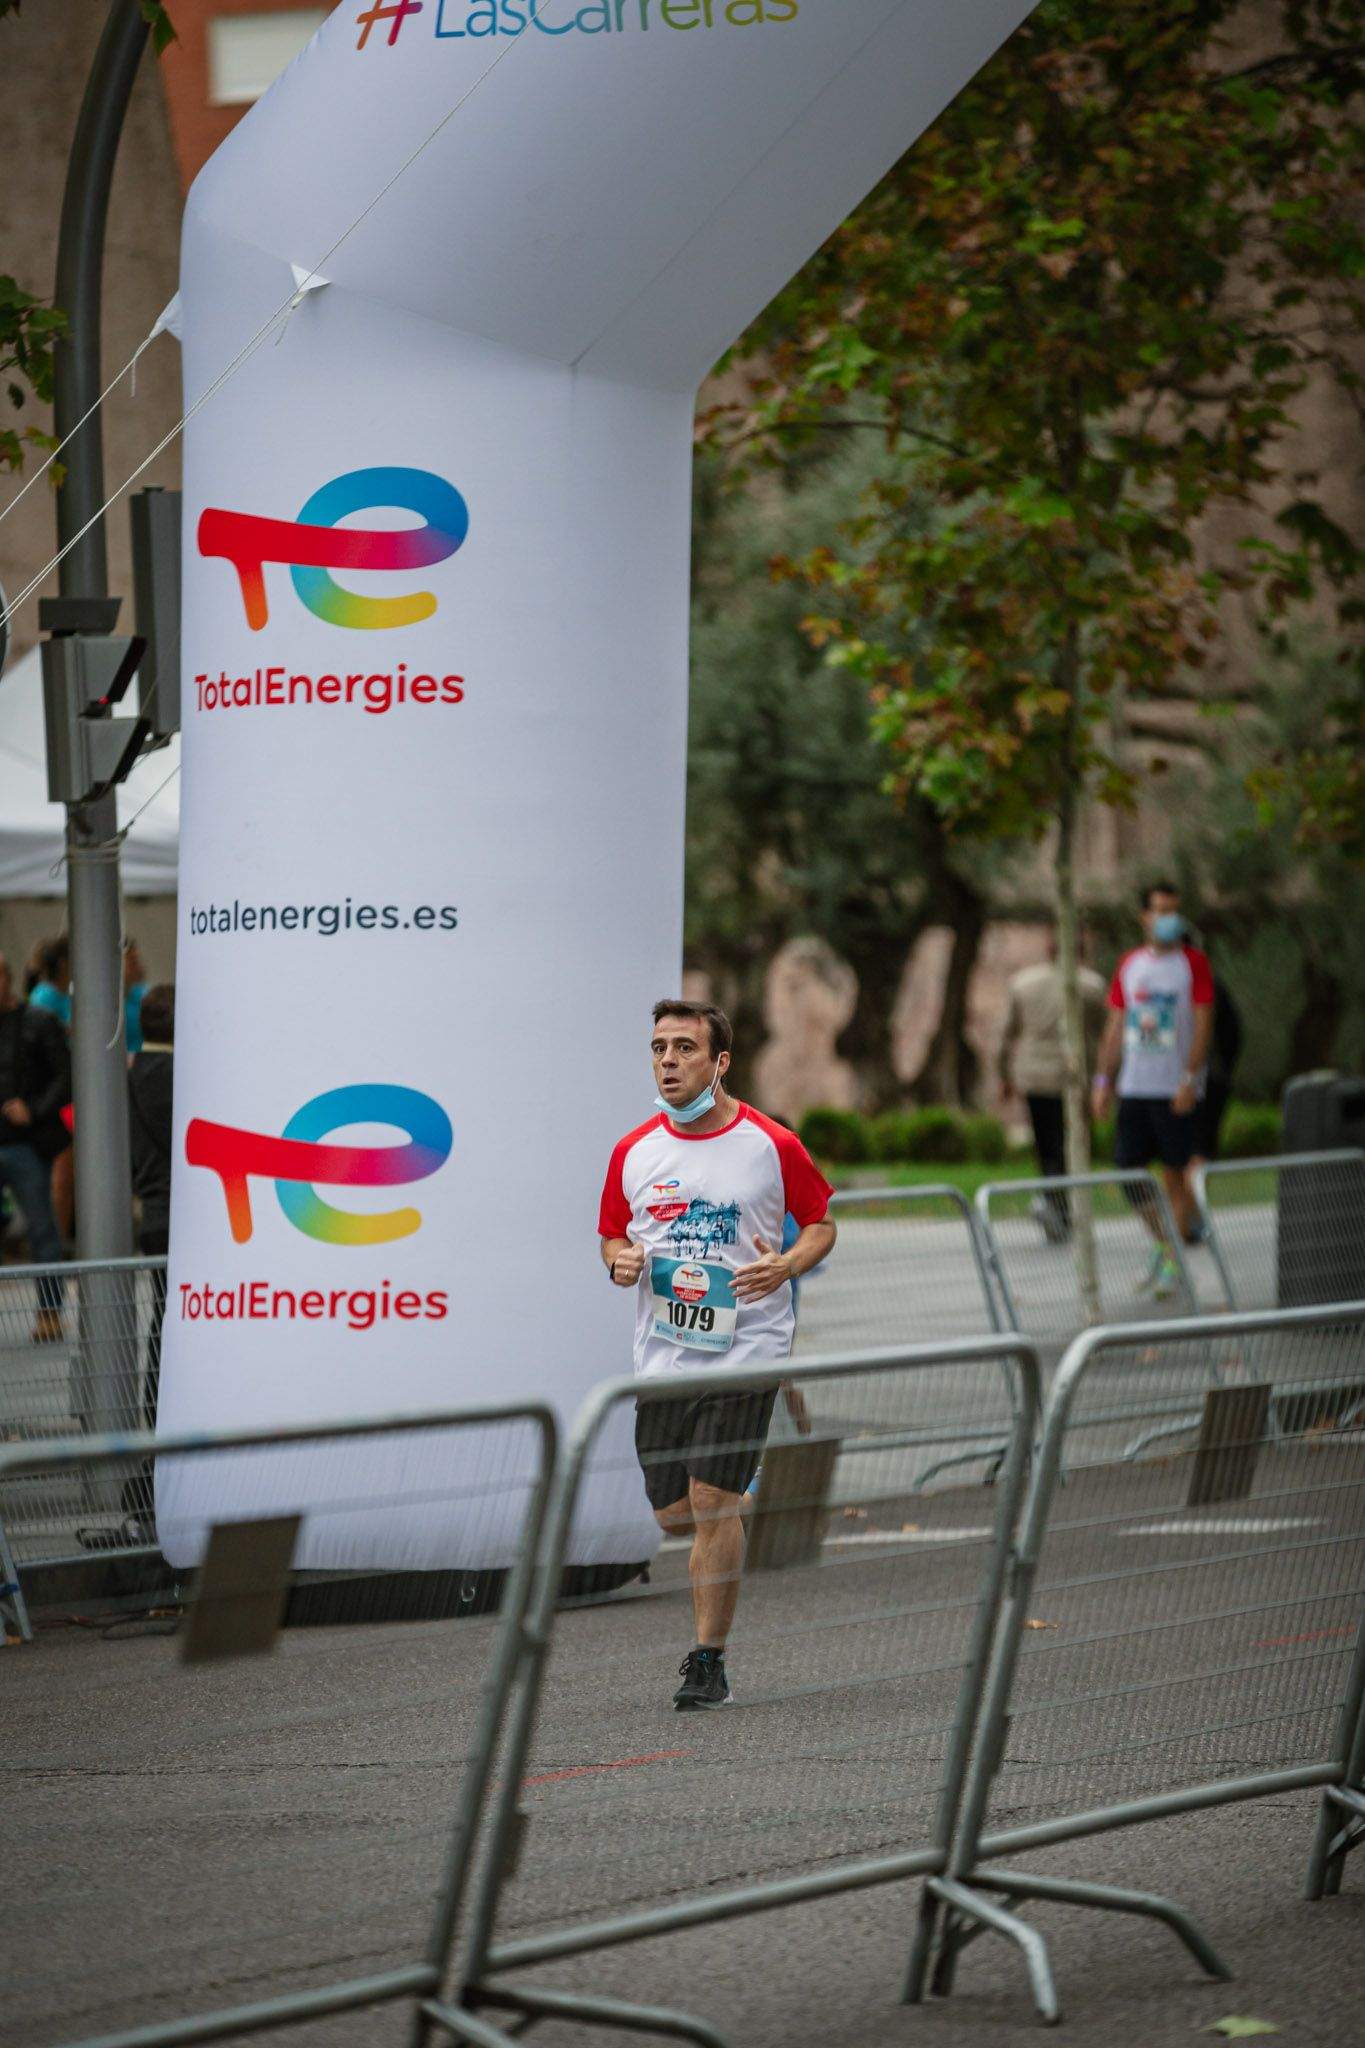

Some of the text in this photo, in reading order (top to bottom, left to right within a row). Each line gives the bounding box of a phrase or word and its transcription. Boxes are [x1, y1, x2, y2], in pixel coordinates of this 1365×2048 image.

[194, 663, 465, 714] TotalEnergies
[190, 897, 458, 936] totalenergies.es
[179, 1279, 449, 1330] TotalEnergies
[667, 1301, 715, 1333] 1079
